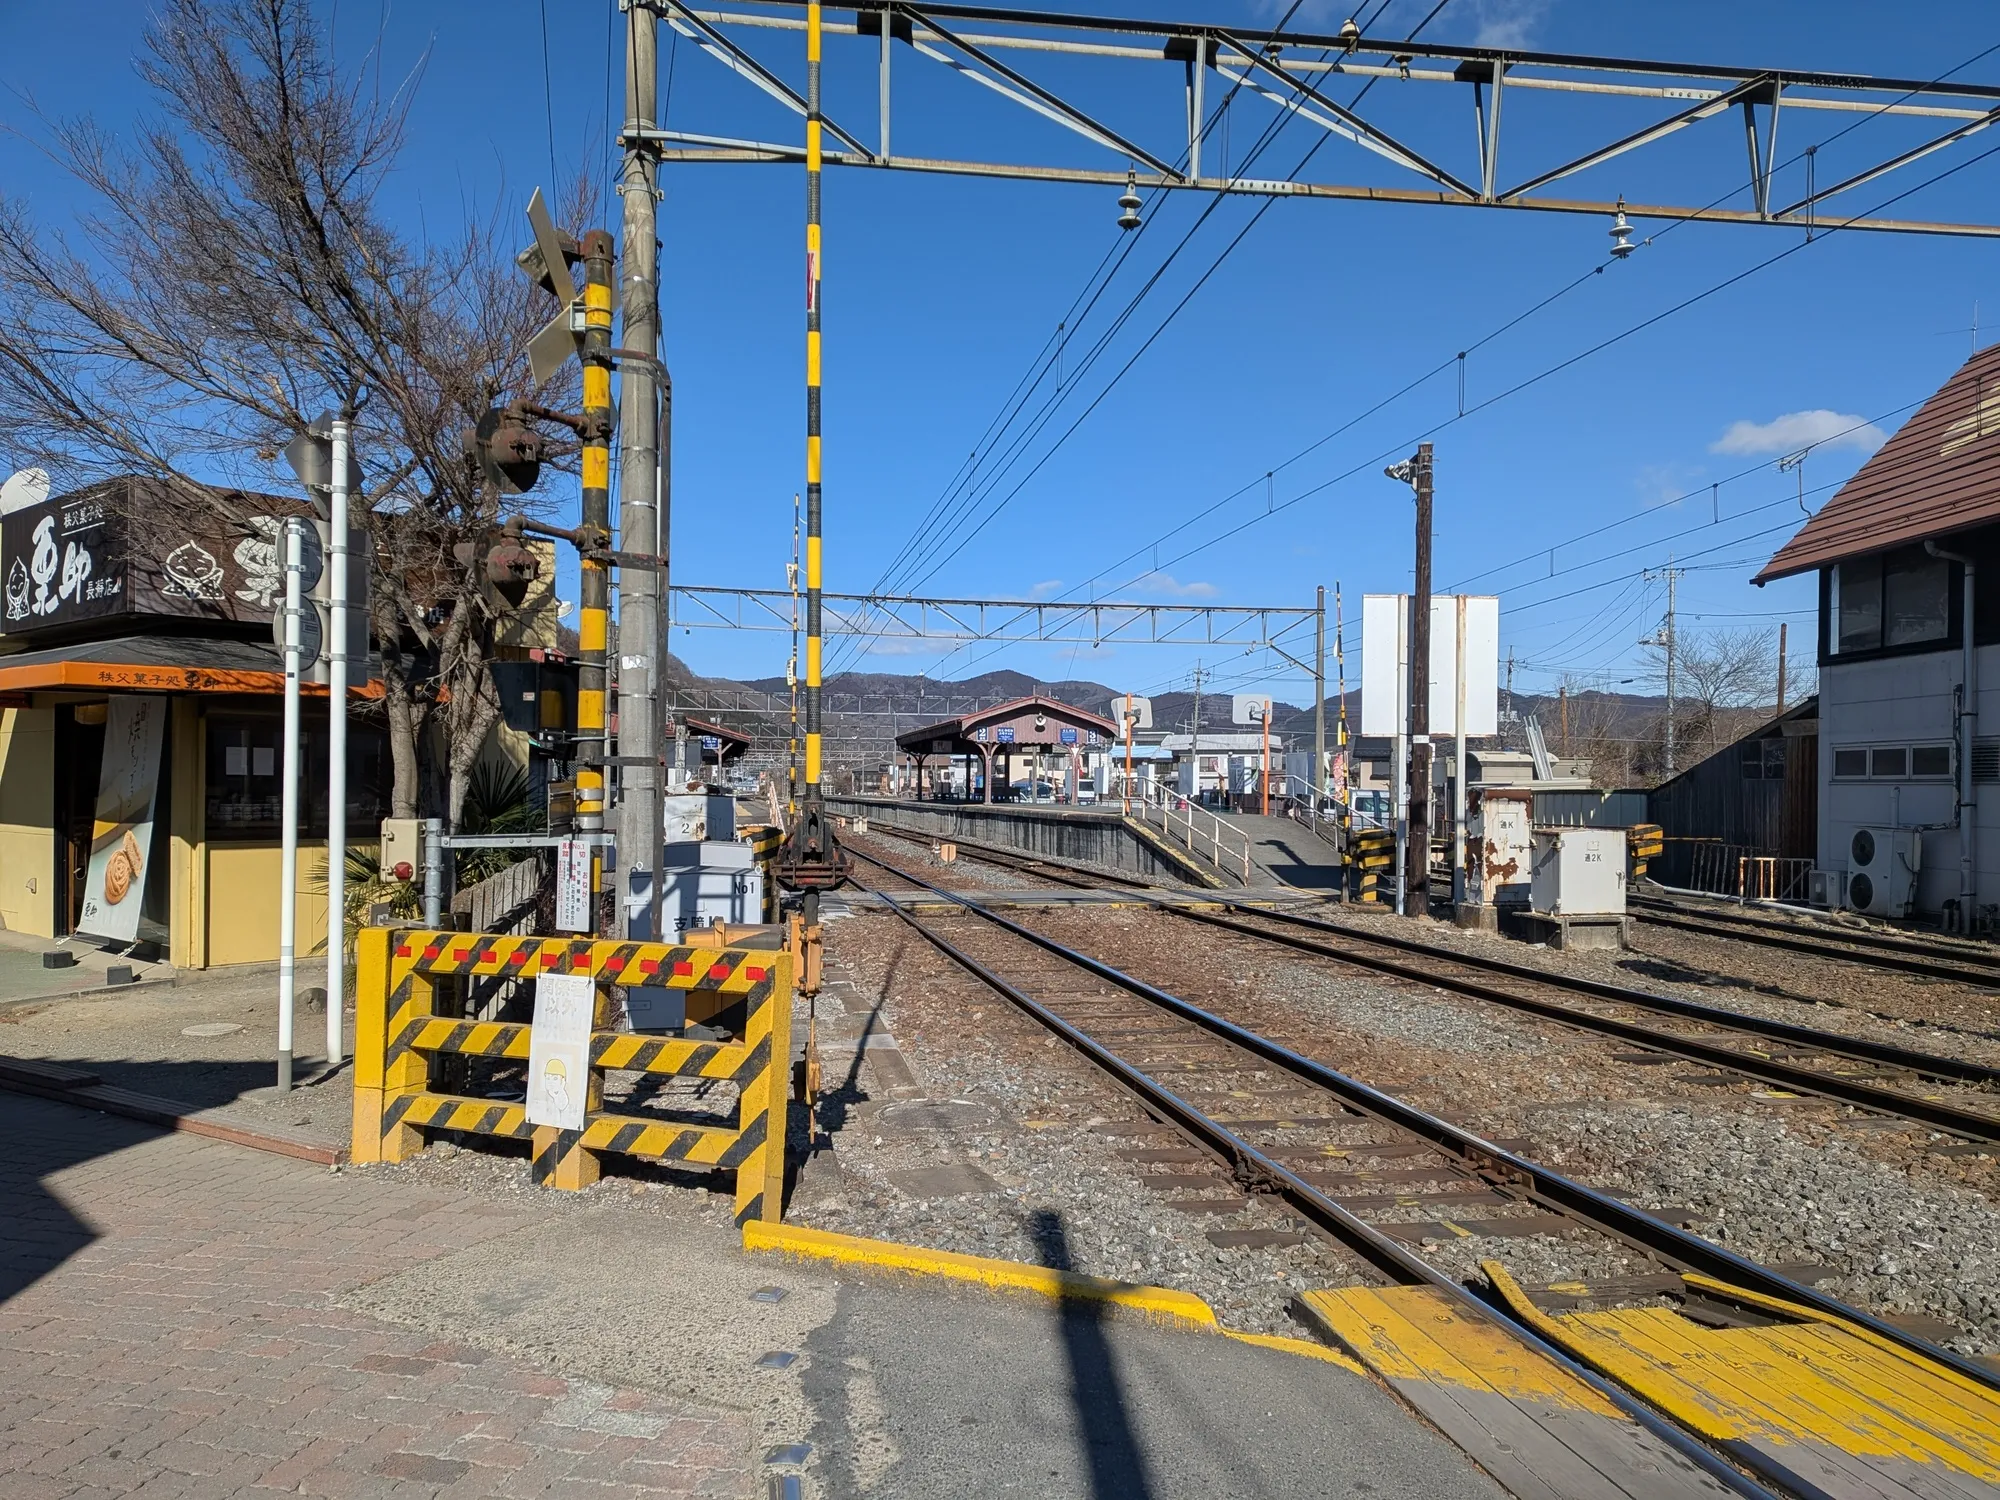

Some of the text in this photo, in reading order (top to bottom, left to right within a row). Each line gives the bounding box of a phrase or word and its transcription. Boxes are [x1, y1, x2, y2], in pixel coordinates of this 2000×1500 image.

[98, 670, 181, 687] 秩父菓子処
[979, 728, 986, 736] 2
[734, 881, 754, 894] No1
